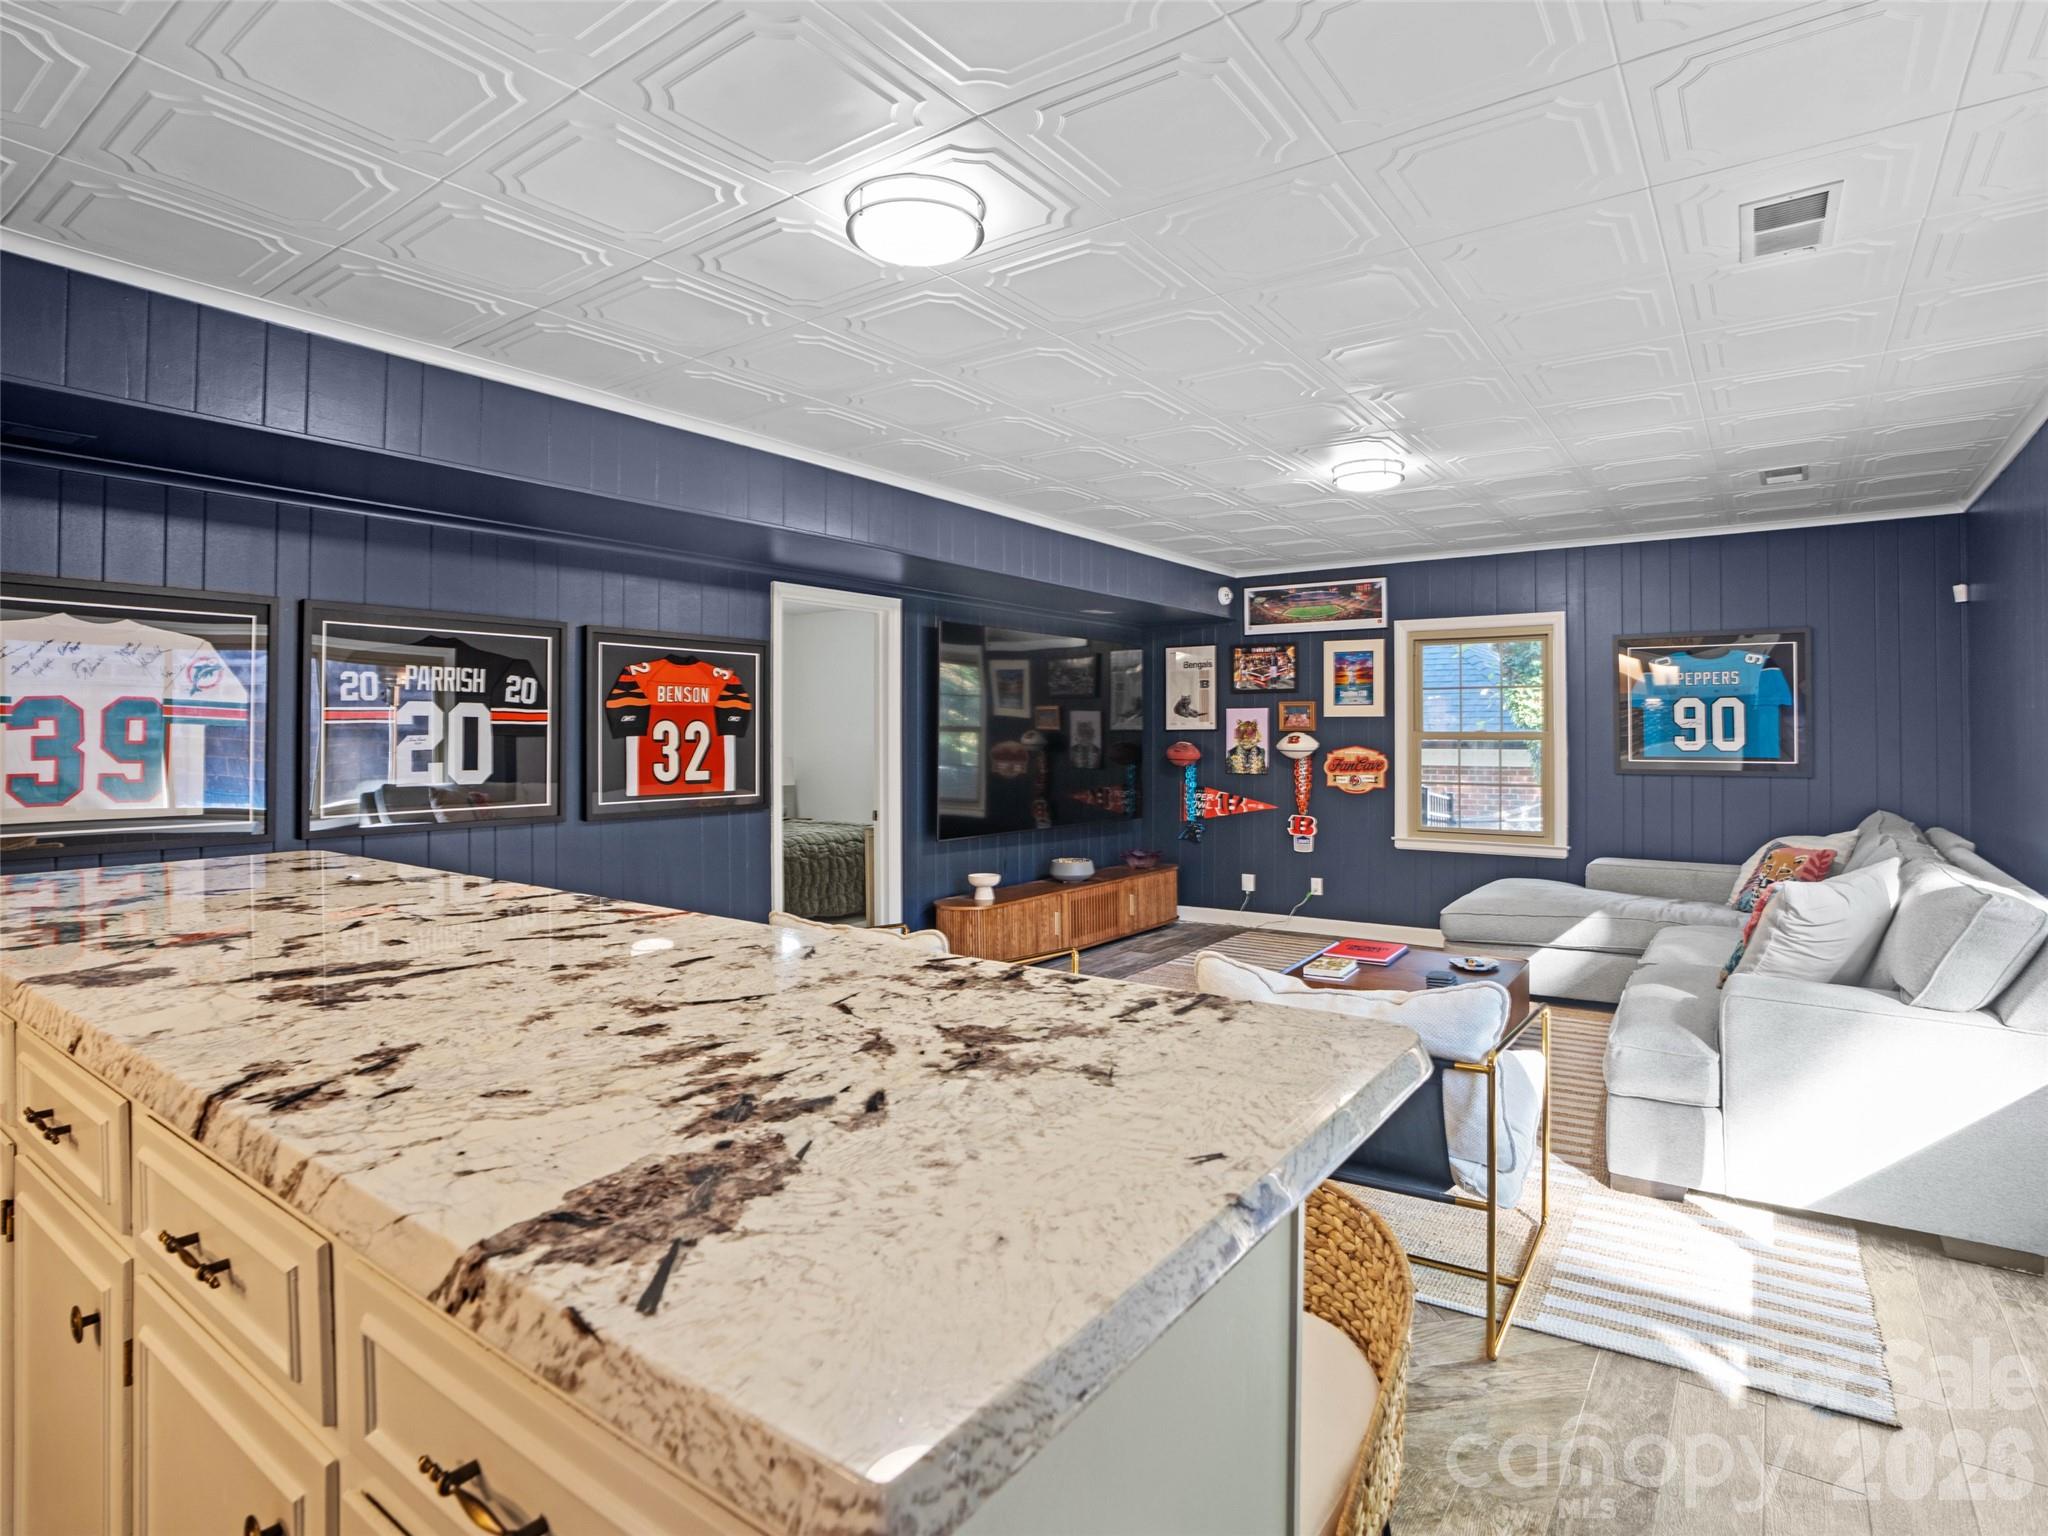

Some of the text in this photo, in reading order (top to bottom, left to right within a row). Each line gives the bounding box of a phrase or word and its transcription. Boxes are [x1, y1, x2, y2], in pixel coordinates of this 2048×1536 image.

[405, 664, 486, 693] PARRISH
[1183, 661, 1213, 670] Bengals
[1678, 671, 1740, 686] PEPPERS
[340, 671, 379, 701] 20
[505, 675, 538, 705] 20
[657, 685, 710, 703] BENSON
[1673, 696, 1746, 752] 90
[4, 695, 170, 808] 39
[396, 700, 494, 788] 20
[652, 719, 712, 784] 32
[1195, 792, 1215, 801] PER
